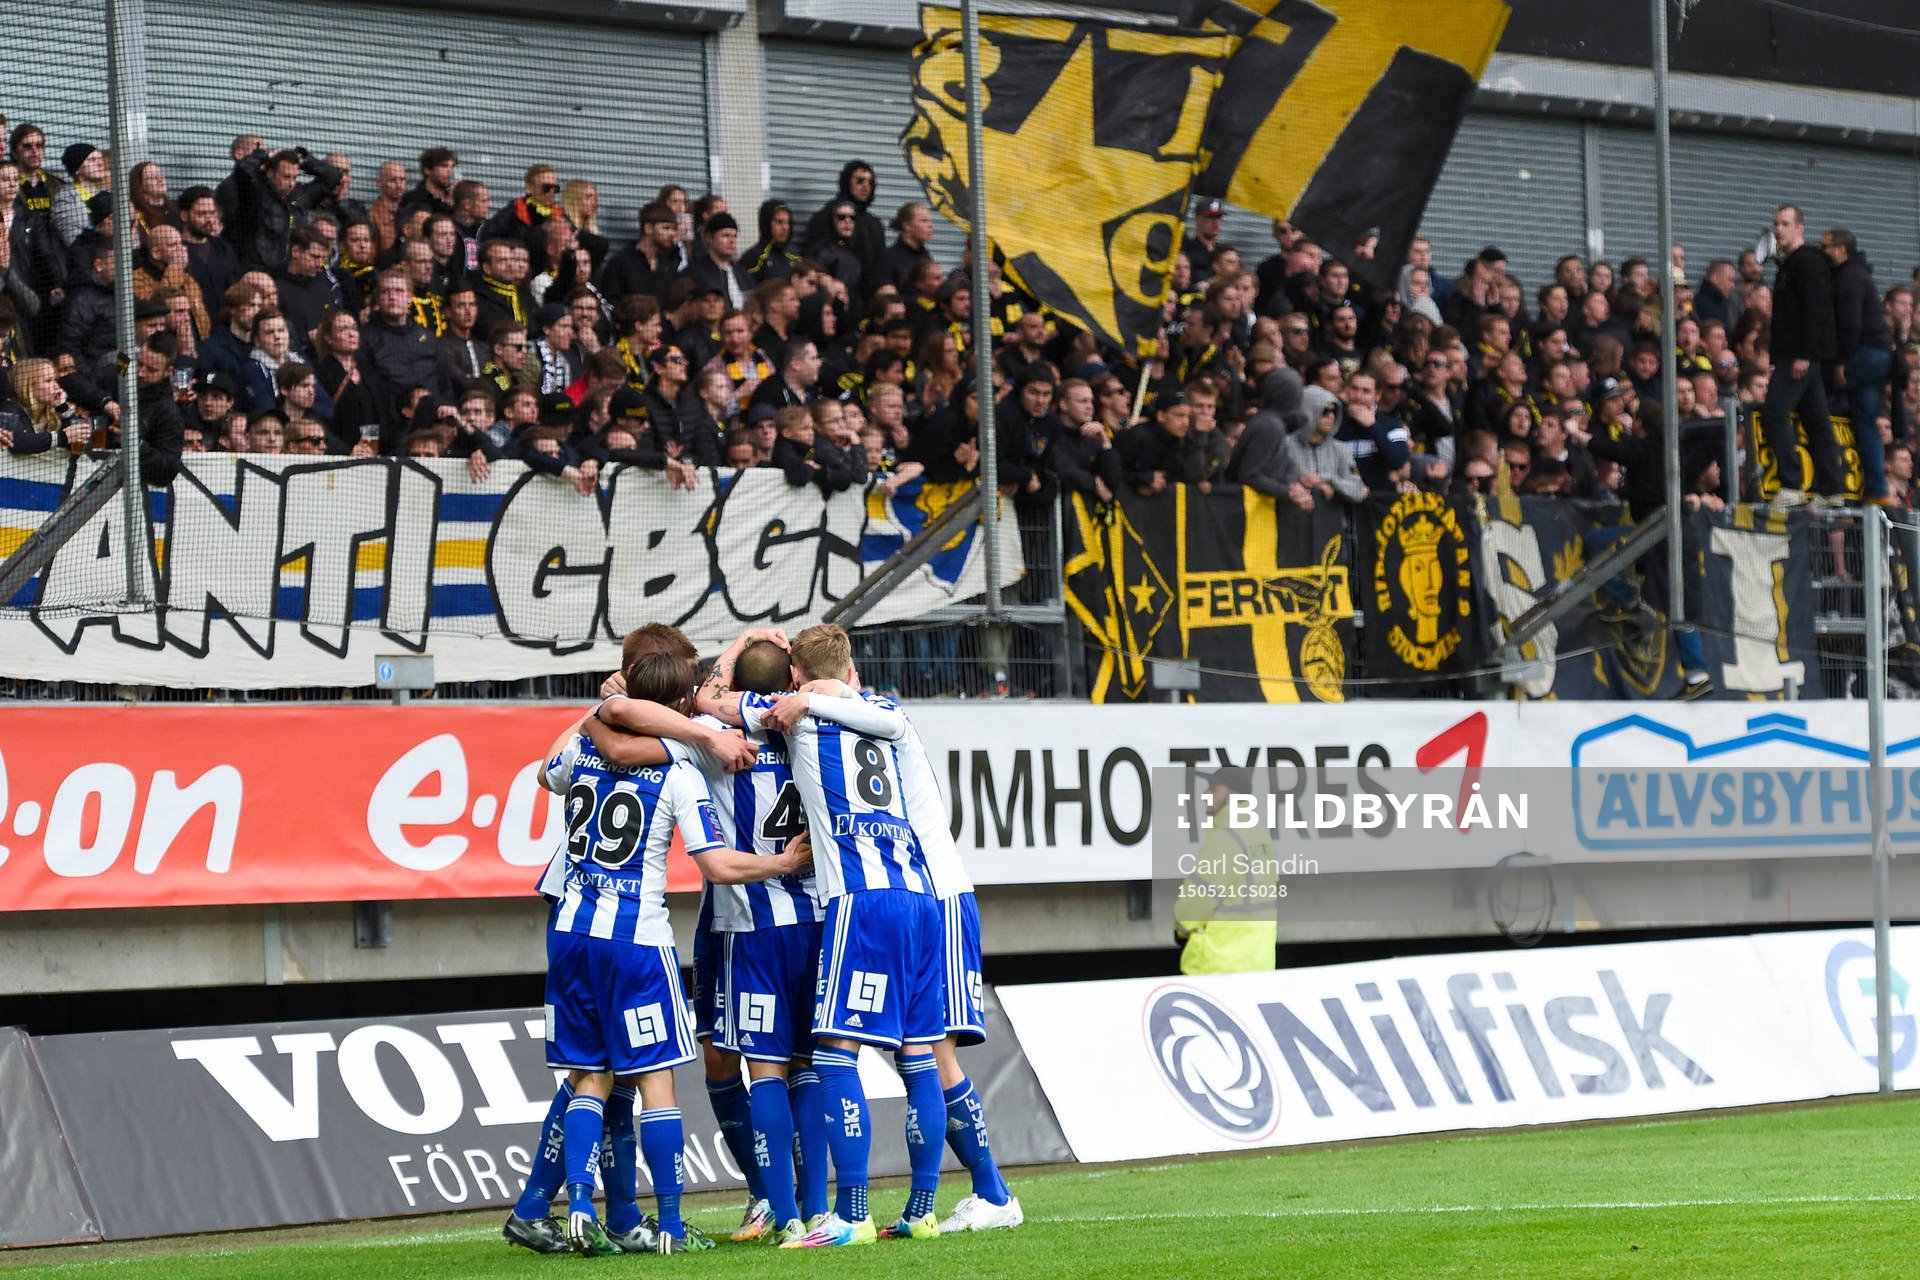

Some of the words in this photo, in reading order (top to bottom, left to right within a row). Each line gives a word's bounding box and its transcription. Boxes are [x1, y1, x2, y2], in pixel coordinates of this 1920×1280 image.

[30, 453, 443, 659] ANTI
[485, 460, 877, 657] GBG!
[1186, 573, 1343, 618] FERNT
[577, 753, 664, 785] EHRENBORG
[854, 737, 893, 810] 8
[568, 782, 644, 869] 29
[760, 779, 809, 849] 4
[1257, 969, 1714, 1118] Nilfisk
[841, 1097, 863, 1138] SKF
[965, 1098, 989, 1148] SKF
[753, 1129, 771, 1168] SKF
